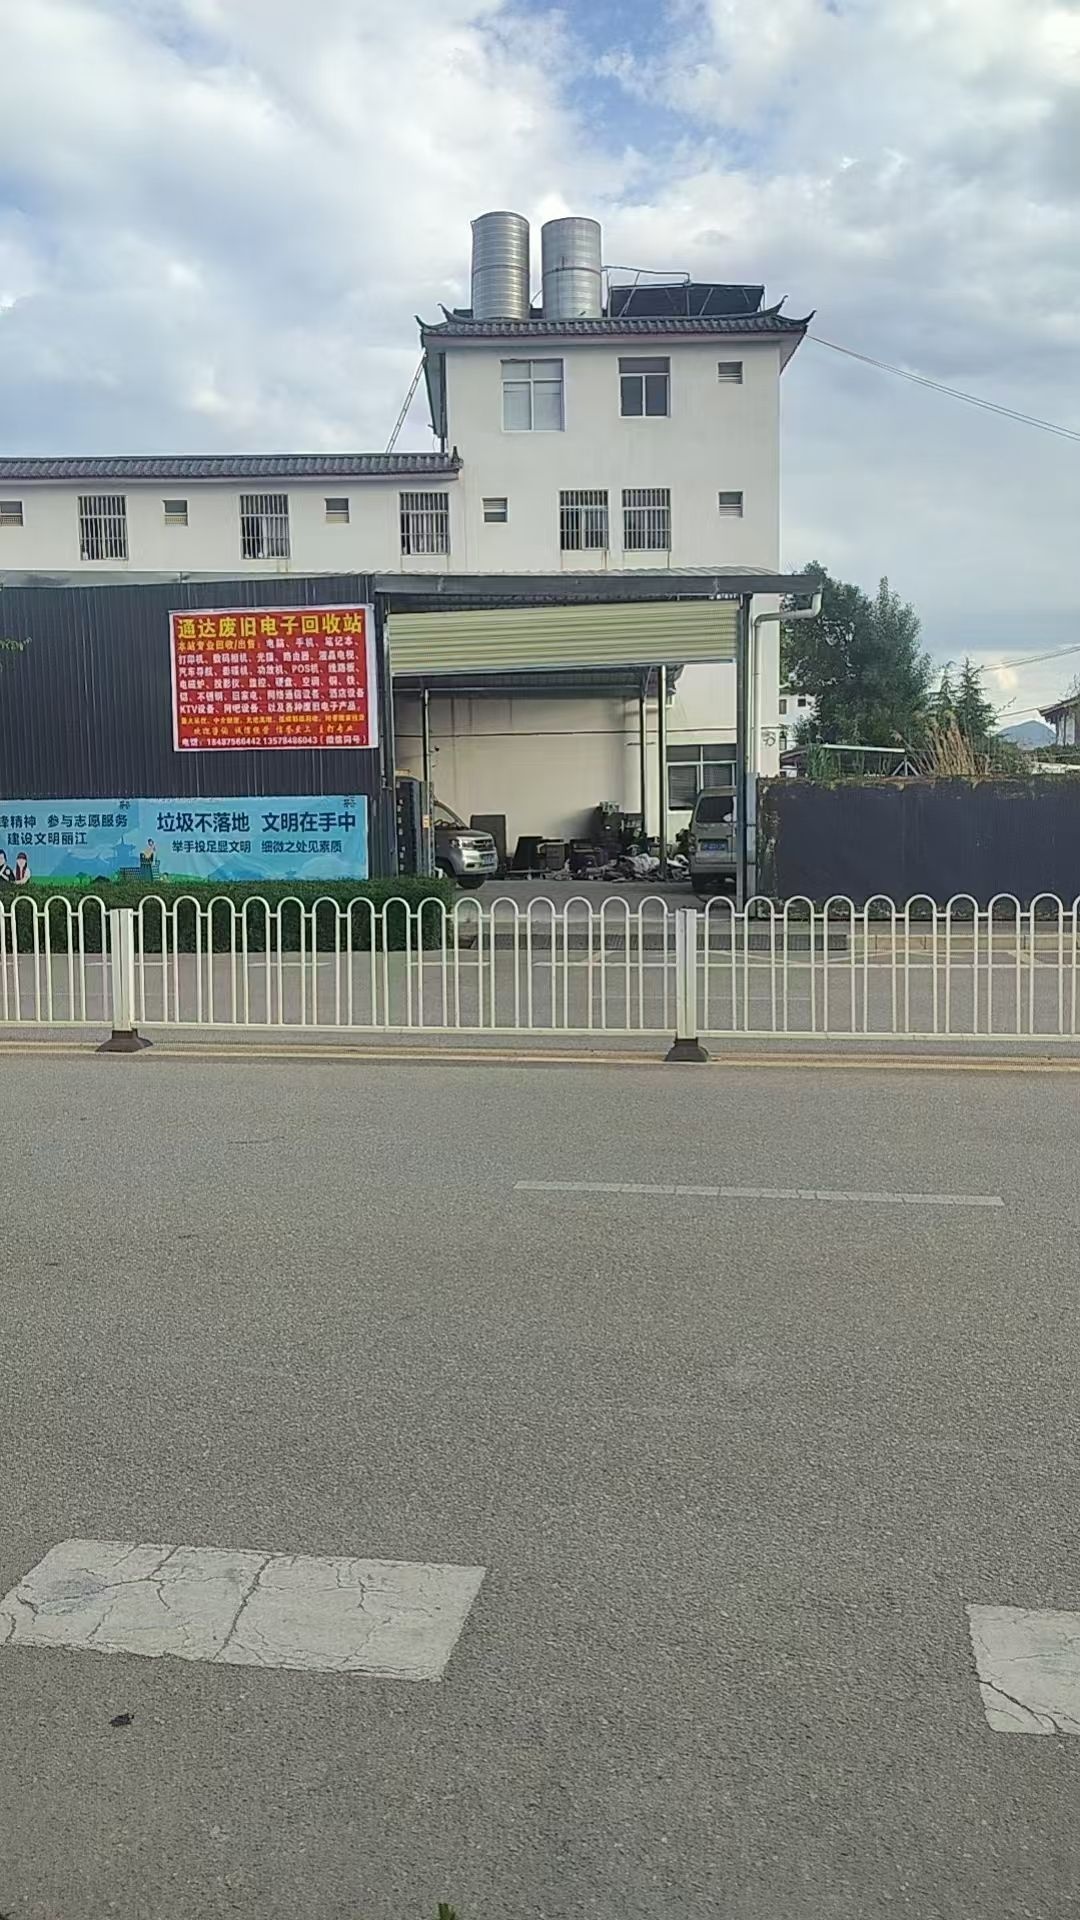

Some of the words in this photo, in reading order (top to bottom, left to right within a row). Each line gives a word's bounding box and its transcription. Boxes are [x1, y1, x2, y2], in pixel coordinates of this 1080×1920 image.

[178, 613, 362, 638] 通达废旧电子回收站
[47, 813, 127, 828] 参与志愿服务
[157, 811, 250, 832] 垃圾不落地
[261, 811, 355, 832] 文明在手中
[7, 832, 88, 846] 建设文明丽江
[172, 839, 251, 853] 举手投足显文明
[261, 839, 342, 853] 细微之处见素质
